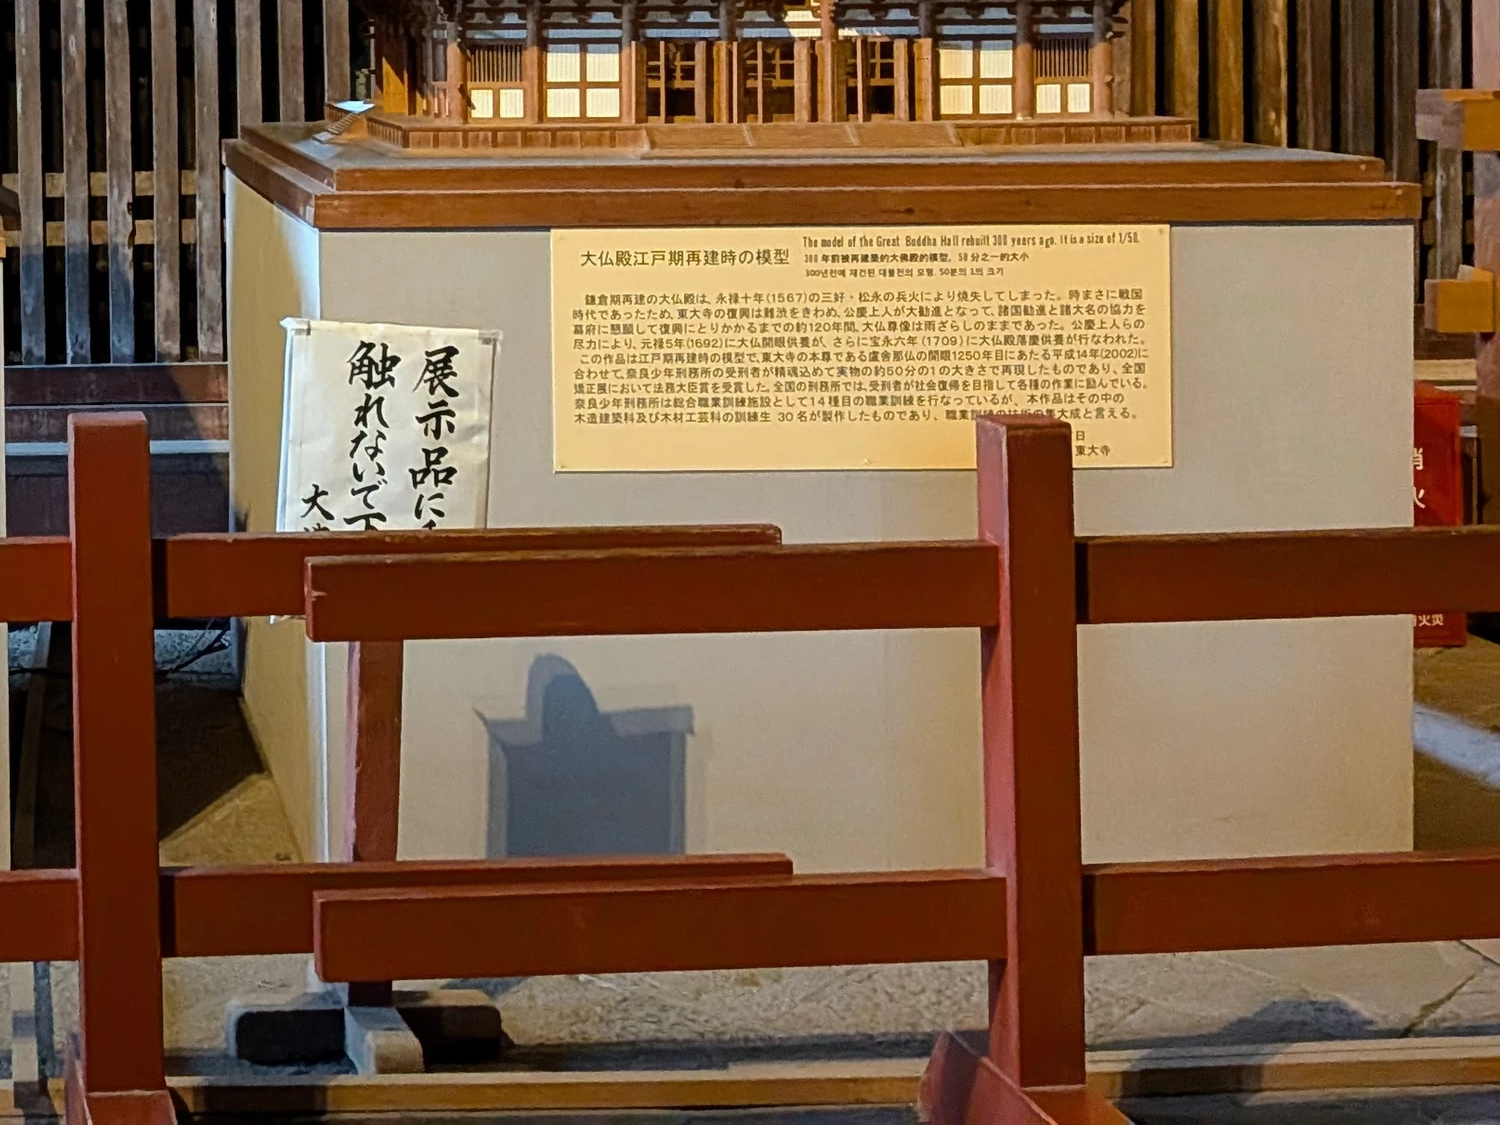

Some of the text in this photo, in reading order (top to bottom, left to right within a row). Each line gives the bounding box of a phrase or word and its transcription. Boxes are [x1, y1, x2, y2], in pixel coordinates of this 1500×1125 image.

[803, 236, 819, 248] The
[821, 236, 844, 248] model
[848, 236, 857, 248] of
[859, 235, 874, 247] the
[876, 235, 900, 247] Great
[905, 235, 937, 247] Buddha
[940, 234, 959, 246] Hall
[961, 234, 990, 246] rebuilt
[992, 234, 1008, 246] 300
[1011, 234, 1036, 247] years
[1039, 235, 1057, 248] ago.
[1060, 233, 1069, 245] It
[1070, 233, 1078, 245] is
[1086, 233, 1104, 245] size
[1106, 233, 1116, 245] of
[580, 248, 790, 267] 大仏殿江戸期再建時の模型
[970, 250, 1030, 262] 分之一的大小
[408, 345, 461, 530] 展示品に
[1074, 444, 1111, 457] 東大寺
[300, 483, 335, 531] 大
